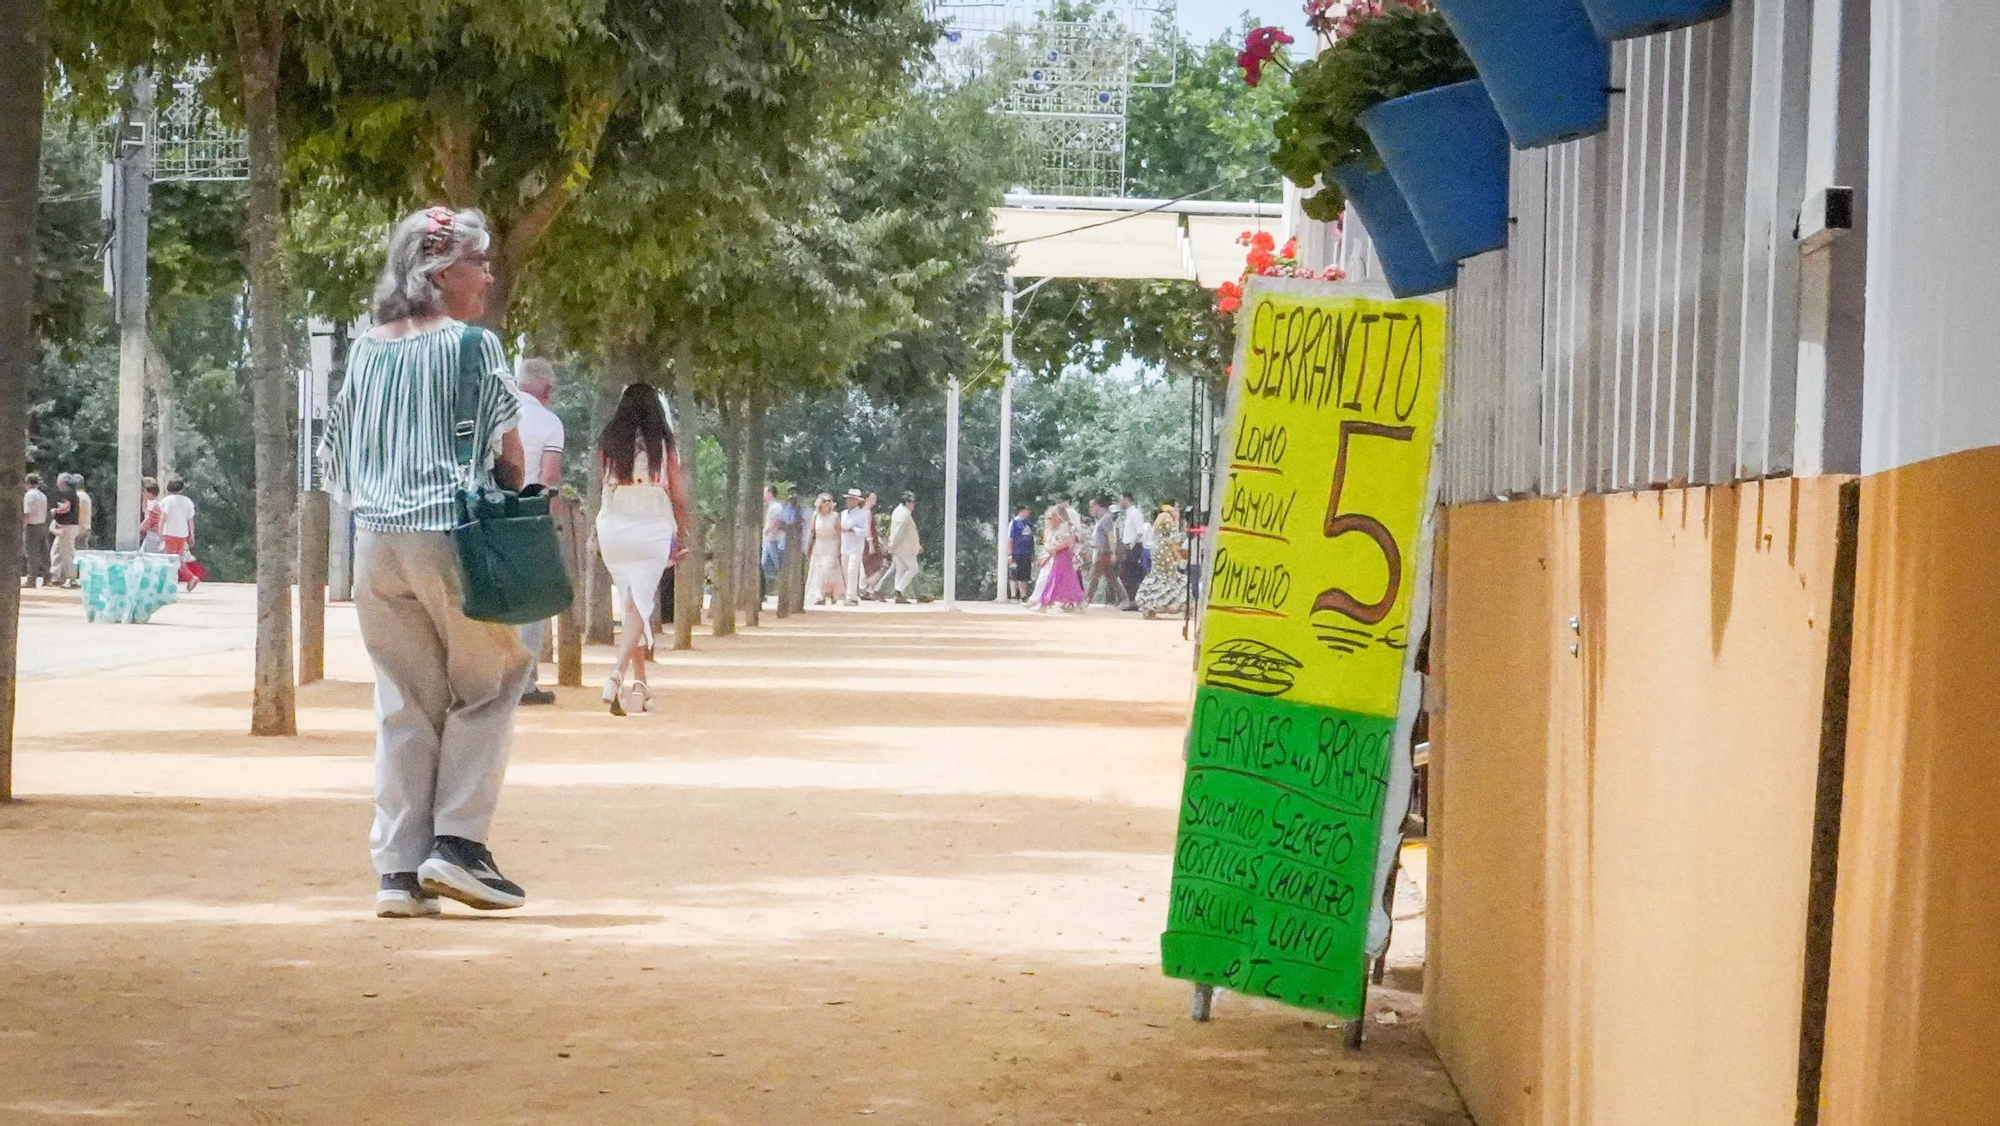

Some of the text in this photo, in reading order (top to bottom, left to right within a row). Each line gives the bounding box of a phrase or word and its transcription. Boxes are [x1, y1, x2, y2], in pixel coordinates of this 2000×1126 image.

[1246, 301, 1422, 422] SERRANITO
[1235, 415, 1287, 464] LOMO
[1221, 473, 1297, 533] JAMON
[1309, 421, 1415, 625] 5
[1208, 547, 1291, 609] PIMIENTO
[1199, 695, 1292, 770] CARNES
[1312, 717, 1391, 814] BRASA
[1269, 793, 1354, 864] SECRETO
[1268, 862, 1355, 917] CHORIZO
[1268, 912, 1334, 962] LOMO
